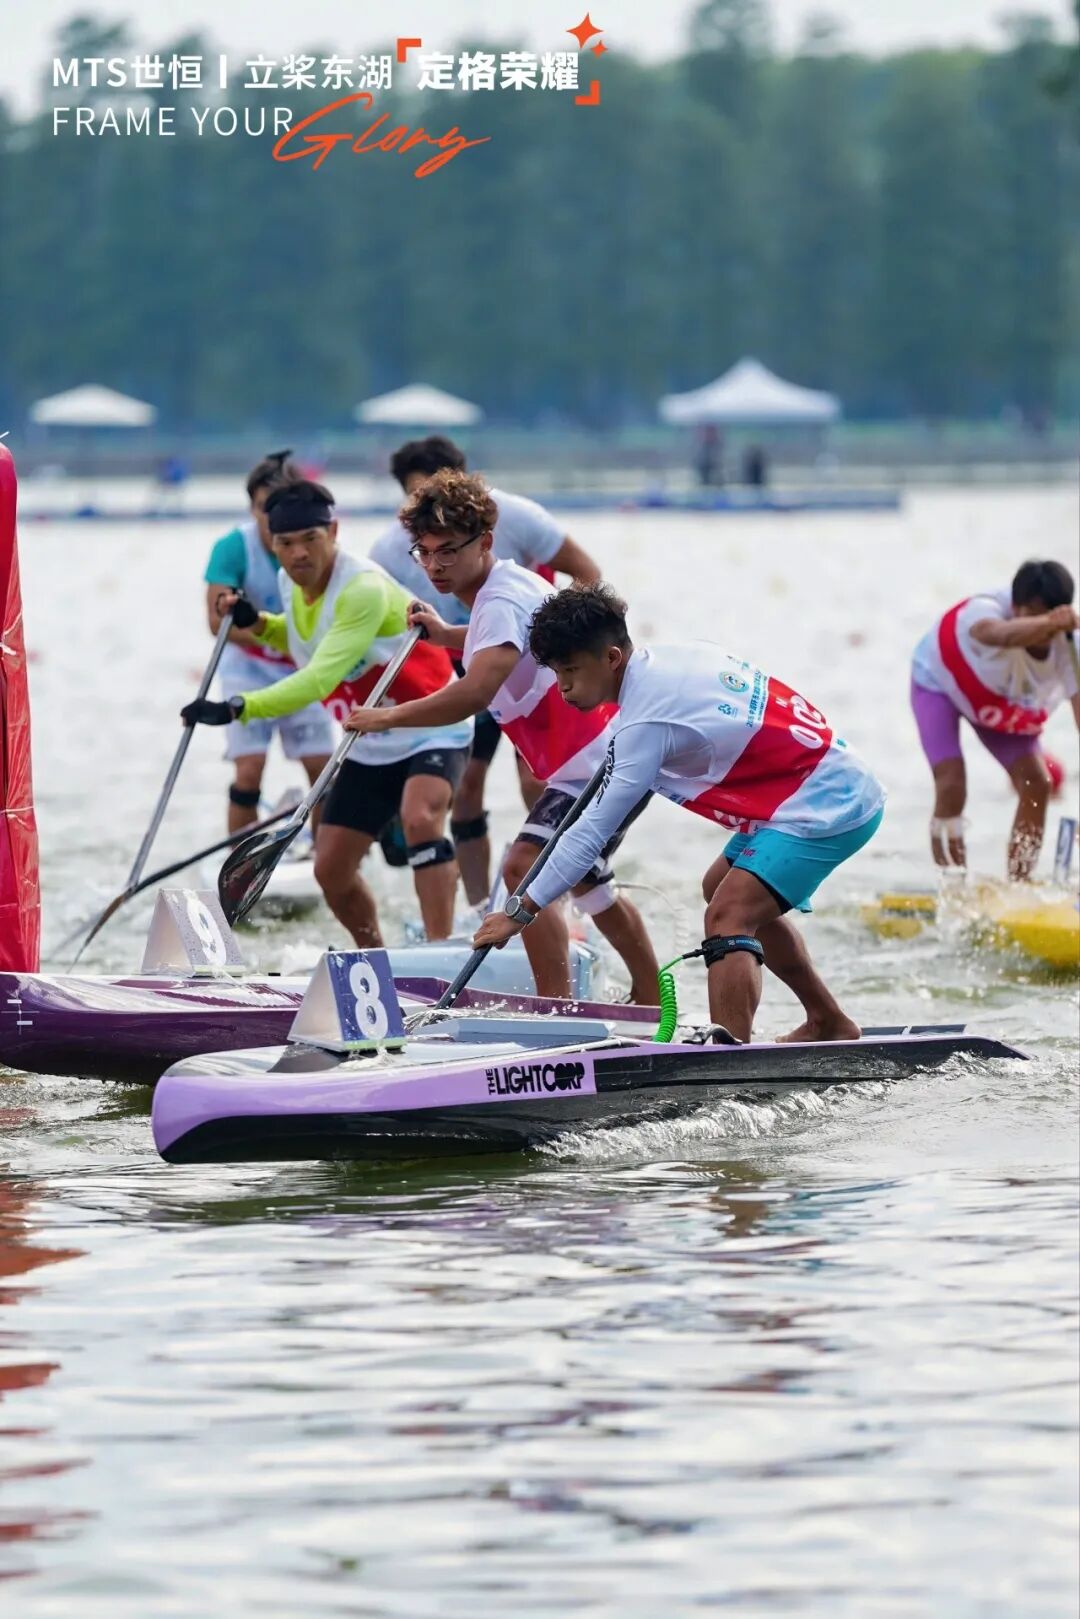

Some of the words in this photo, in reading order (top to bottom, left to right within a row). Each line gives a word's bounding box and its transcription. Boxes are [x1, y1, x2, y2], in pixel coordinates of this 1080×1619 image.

[349, 961, 389, 1039] 8
[485, 1068, 497, 1095] THE
[494, 1062, 586, 1095] LIGHTCORP
